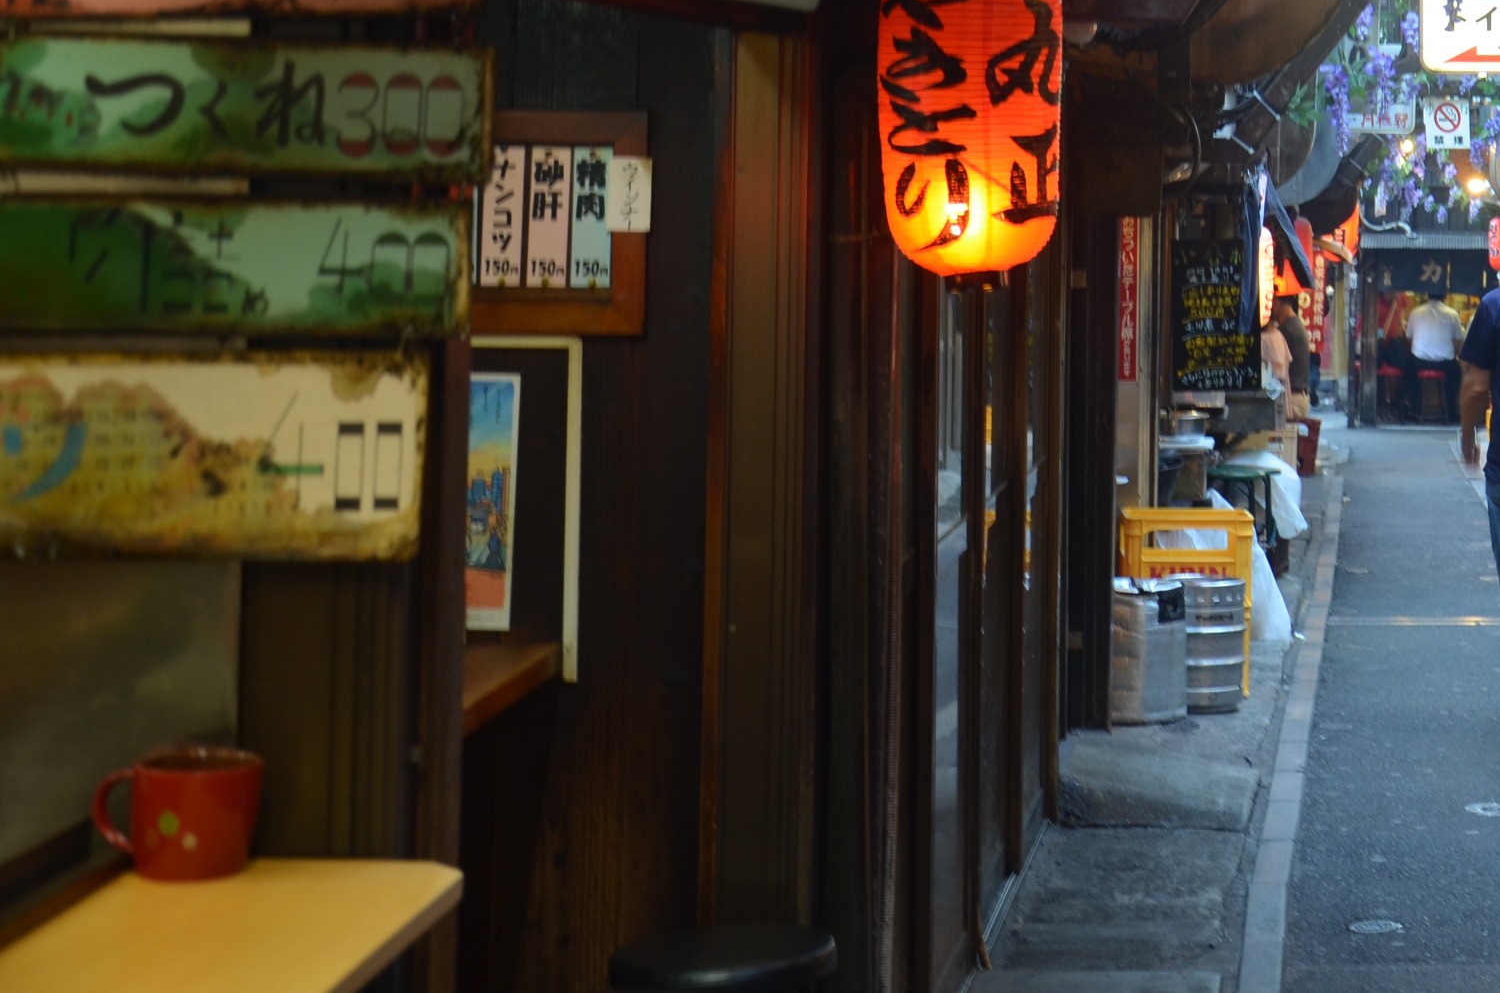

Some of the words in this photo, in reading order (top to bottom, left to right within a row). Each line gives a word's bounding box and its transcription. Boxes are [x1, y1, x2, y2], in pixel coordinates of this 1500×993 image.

[86, 60, 324, 148] つくね
[337, 72, 466, 157] 300
[532, 159, 565, 221] 砂肝
[485, 260, 519, 277] 150円
[531, 260, 565, 277] 150円
[575, 260, 609, 277] 150円
